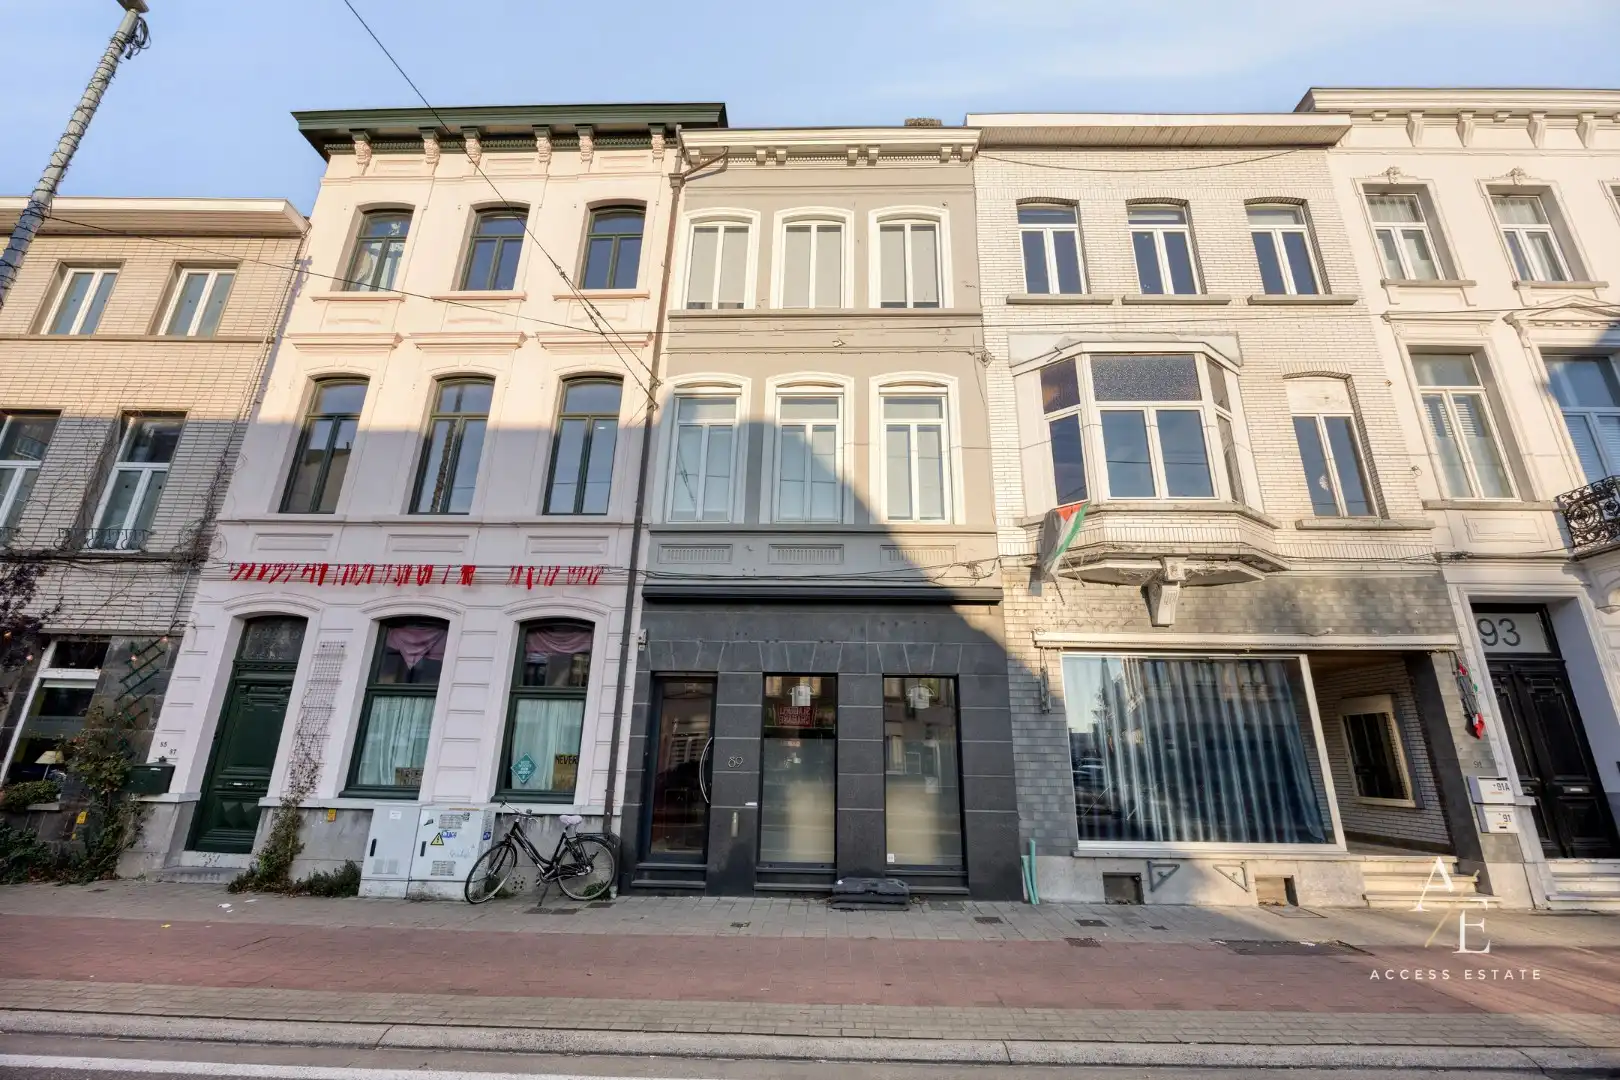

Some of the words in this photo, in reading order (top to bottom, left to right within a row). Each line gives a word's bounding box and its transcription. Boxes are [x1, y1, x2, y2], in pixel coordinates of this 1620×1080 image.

[1477, 618, 1521, 646] 93
[728, 756, 744, 768] 89
[1473, 760, 1483, 769] 91
[1496, 782, 1511, 791] 91A
[1502, 814, 1512, 823] 91
